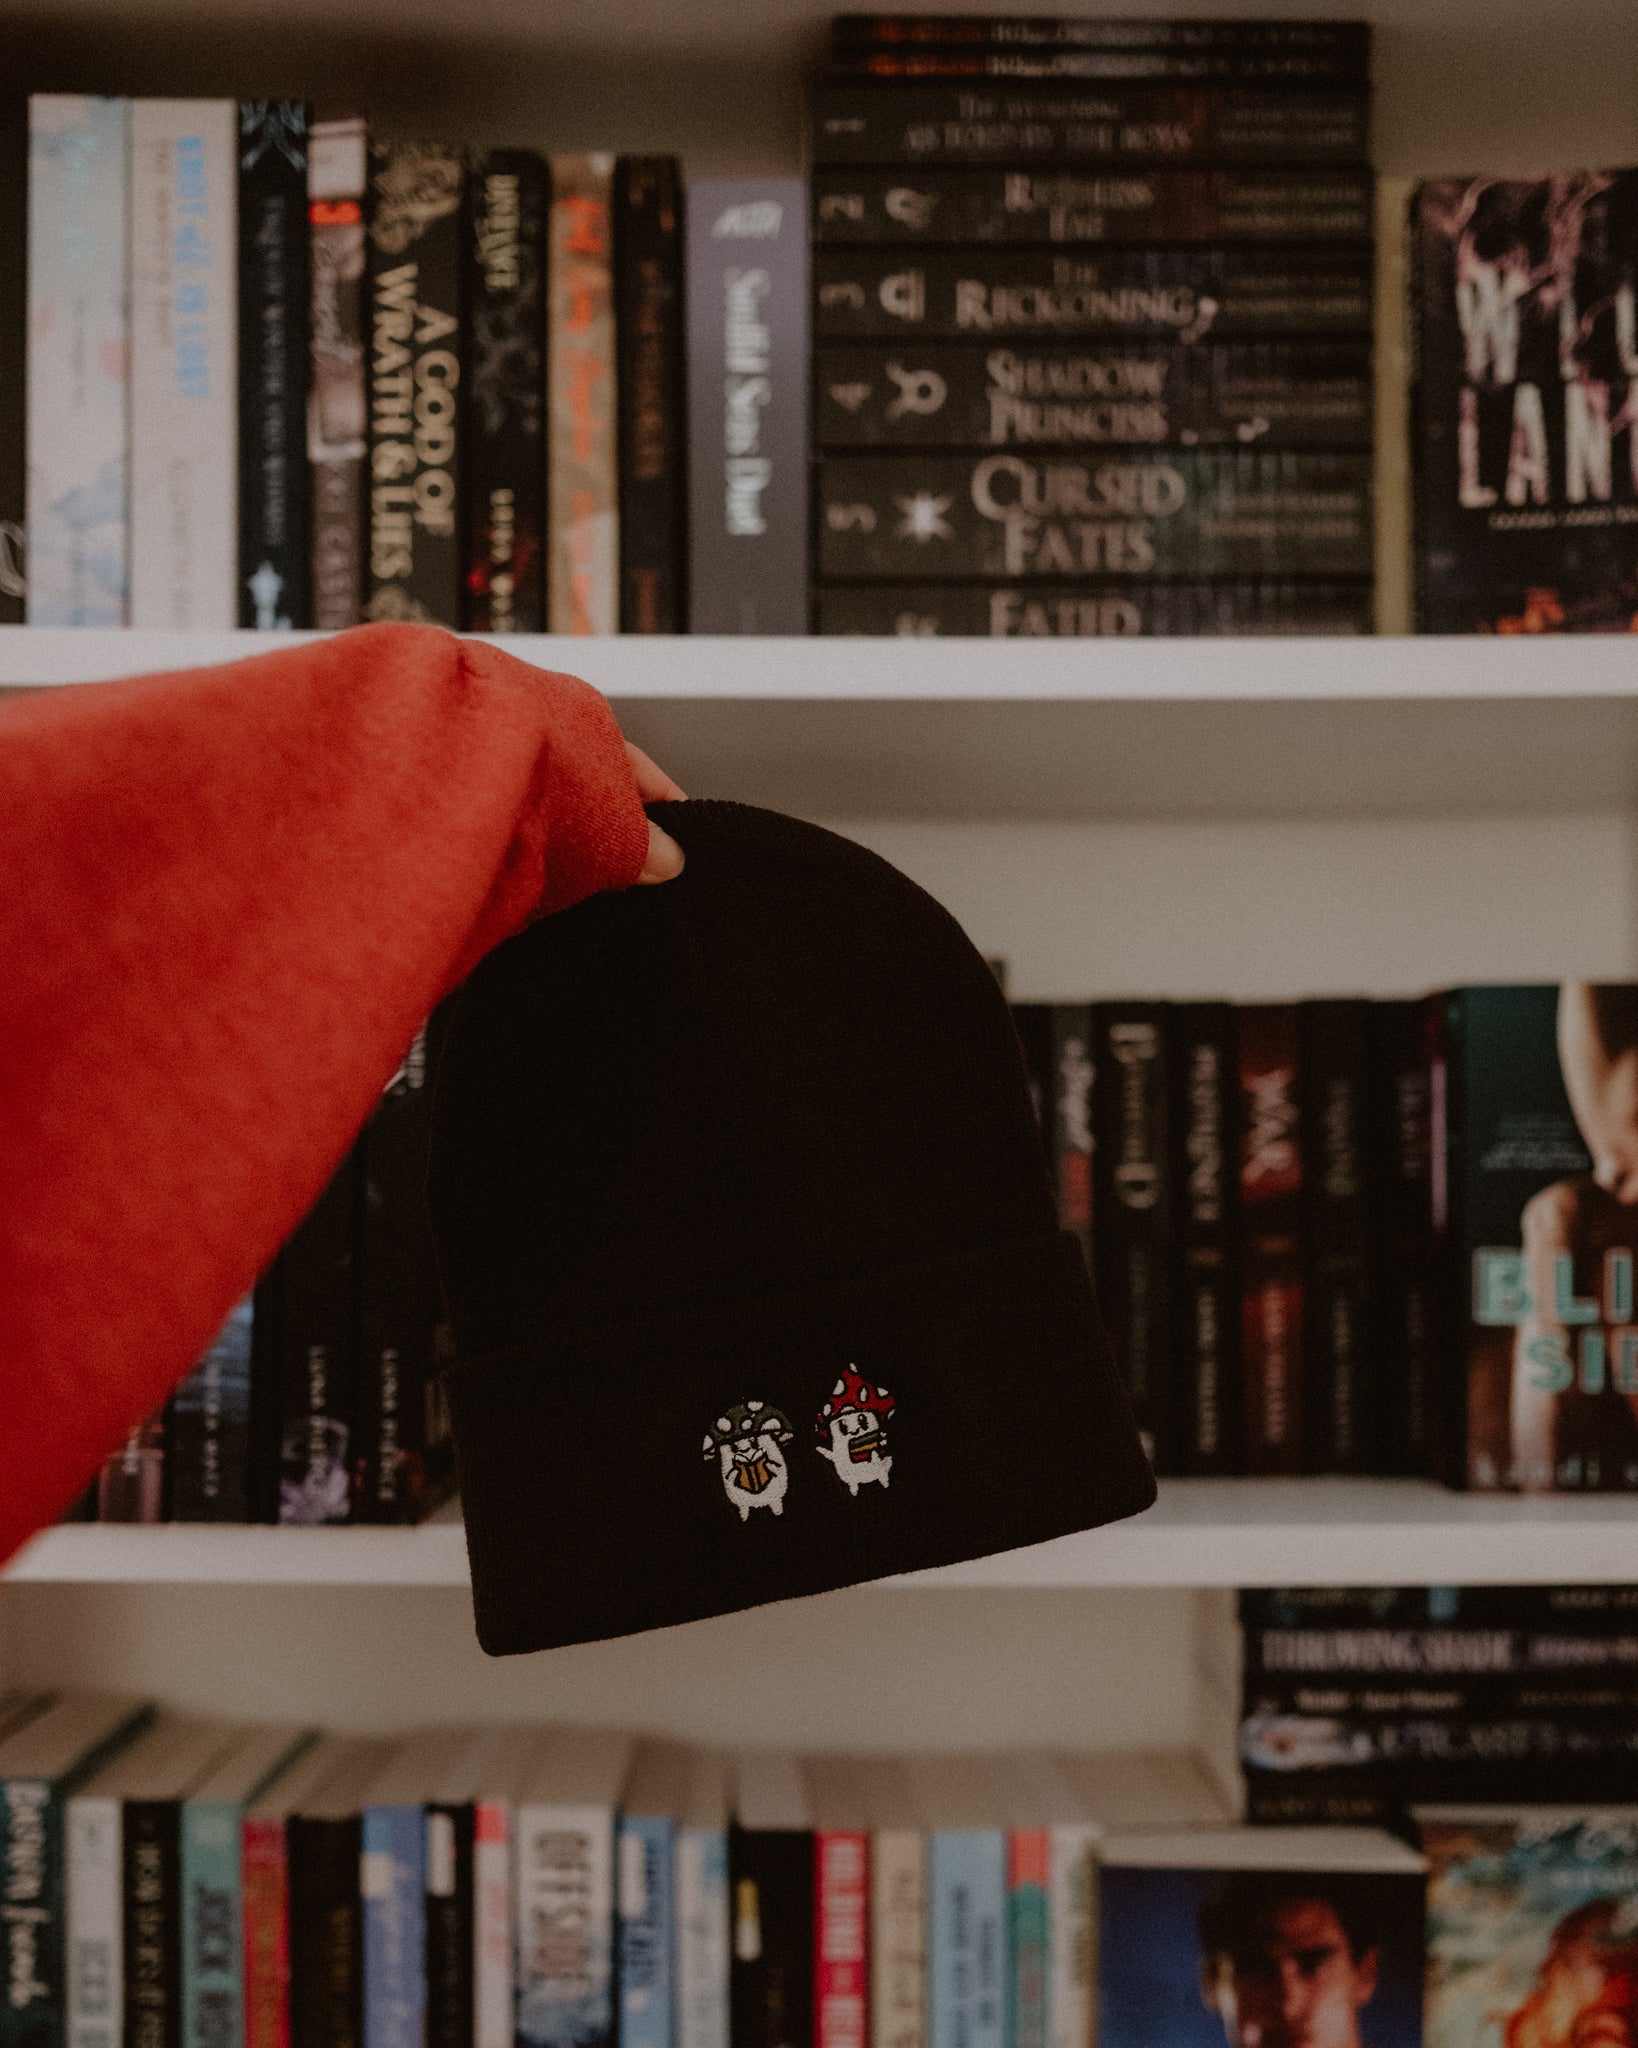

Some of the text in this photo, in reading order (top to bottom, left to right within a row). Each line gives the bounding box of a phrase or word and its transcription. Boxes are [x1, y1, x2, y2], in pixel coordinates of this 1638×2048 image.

[954, 278, 1198, 330] RECKONING
[372, 261, 419, 435] WRATH
[986, 348, 1171, 399] SHADOW
[413, 304, 461, 537] A GOD OF
[986, 386, 1171, 444] PRINCESS
[970, 453, 1187, 521] CURSED
[370, 485, 413, 580] LIES
[1004, 511, 1157, 576] FATES
